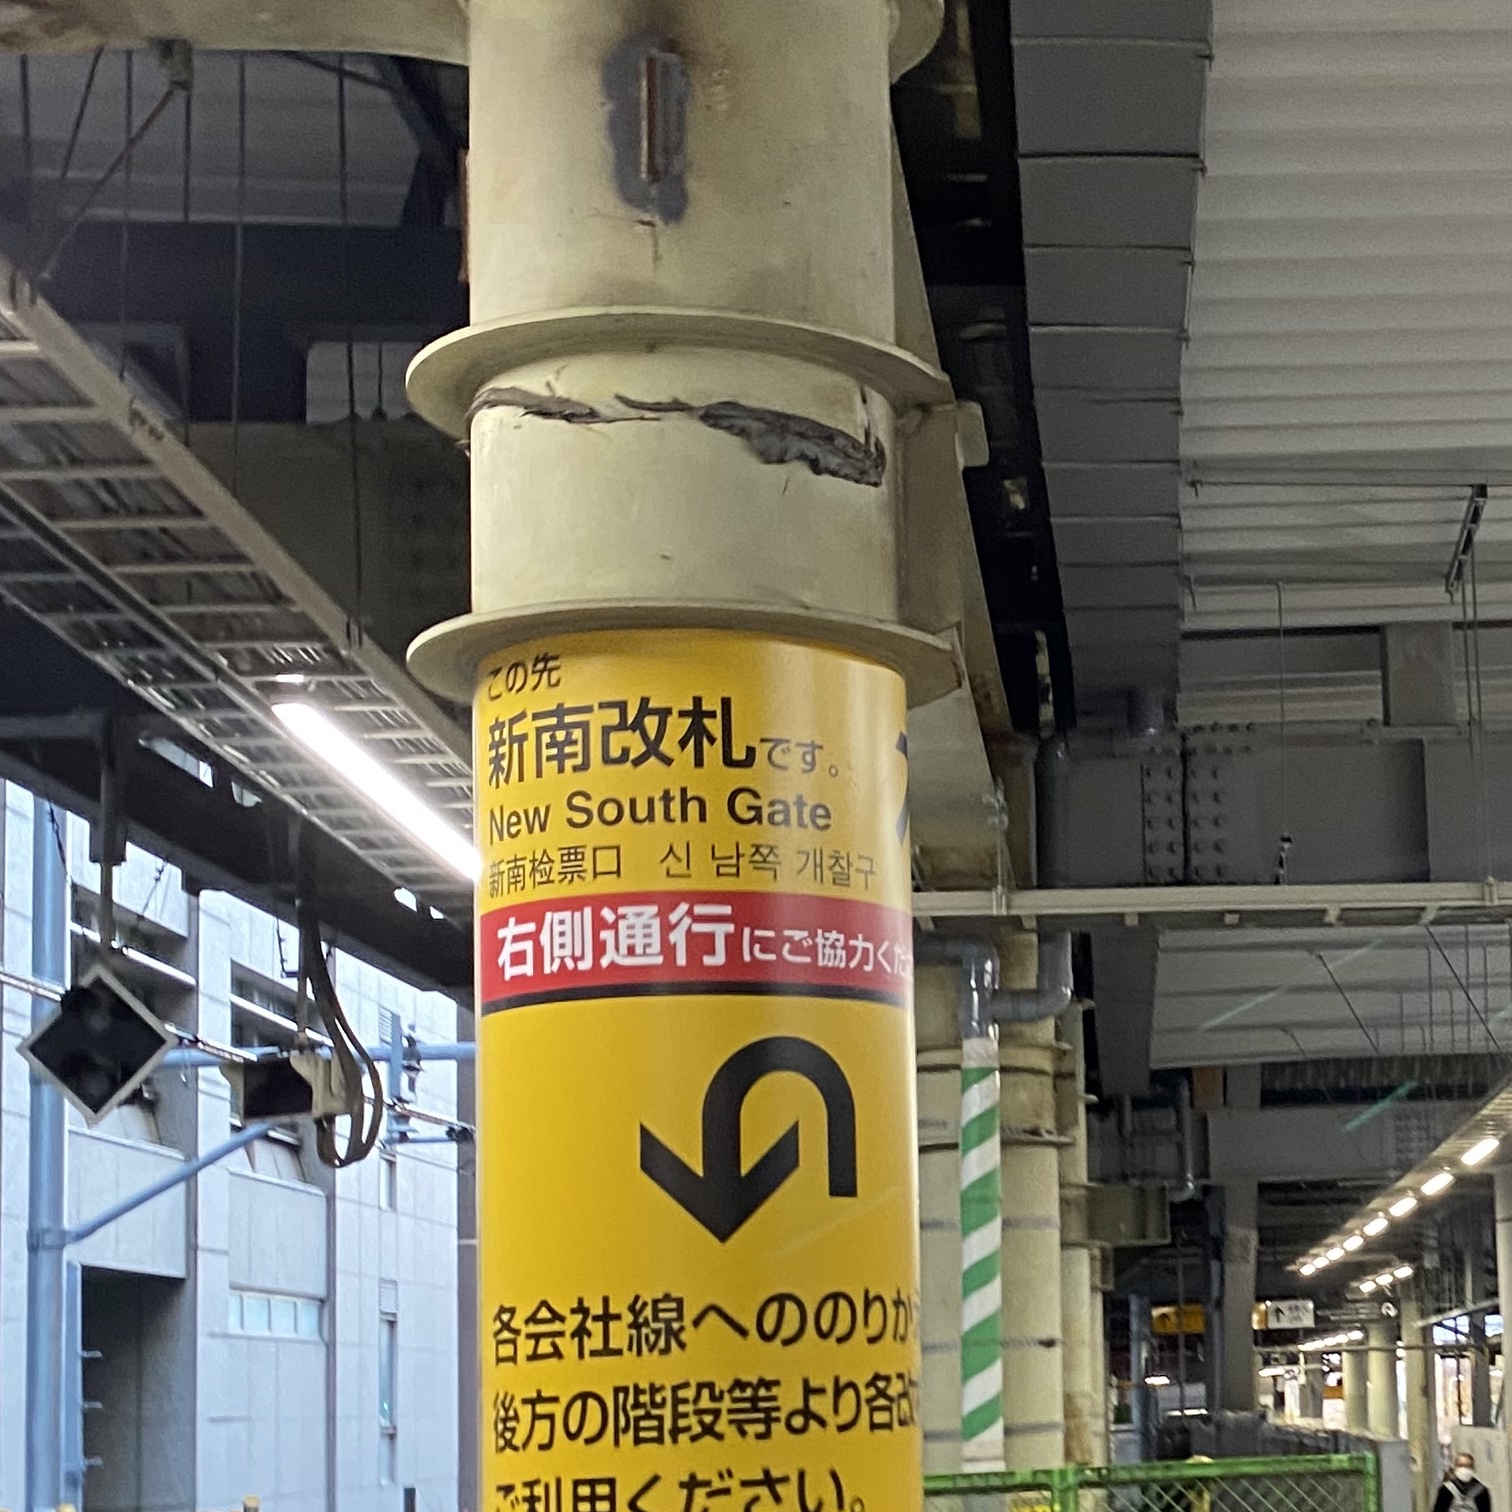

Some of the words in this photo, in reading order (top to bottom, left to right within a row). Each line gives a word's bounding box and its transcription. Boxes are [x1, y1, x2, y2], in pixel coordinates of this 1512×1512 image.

[487, 651, 561, 701] この先
[489, 804, 551, 845] New
[566, 785, 707, 829] South
[727, 786, 832, 831] Gate
[488, 844, 622, 898] 新南检票口
[660, 841, 692, 879] 신
[711, 843, 781, 882] 남쪽
[797, 846, 878, 891] 개찰구
